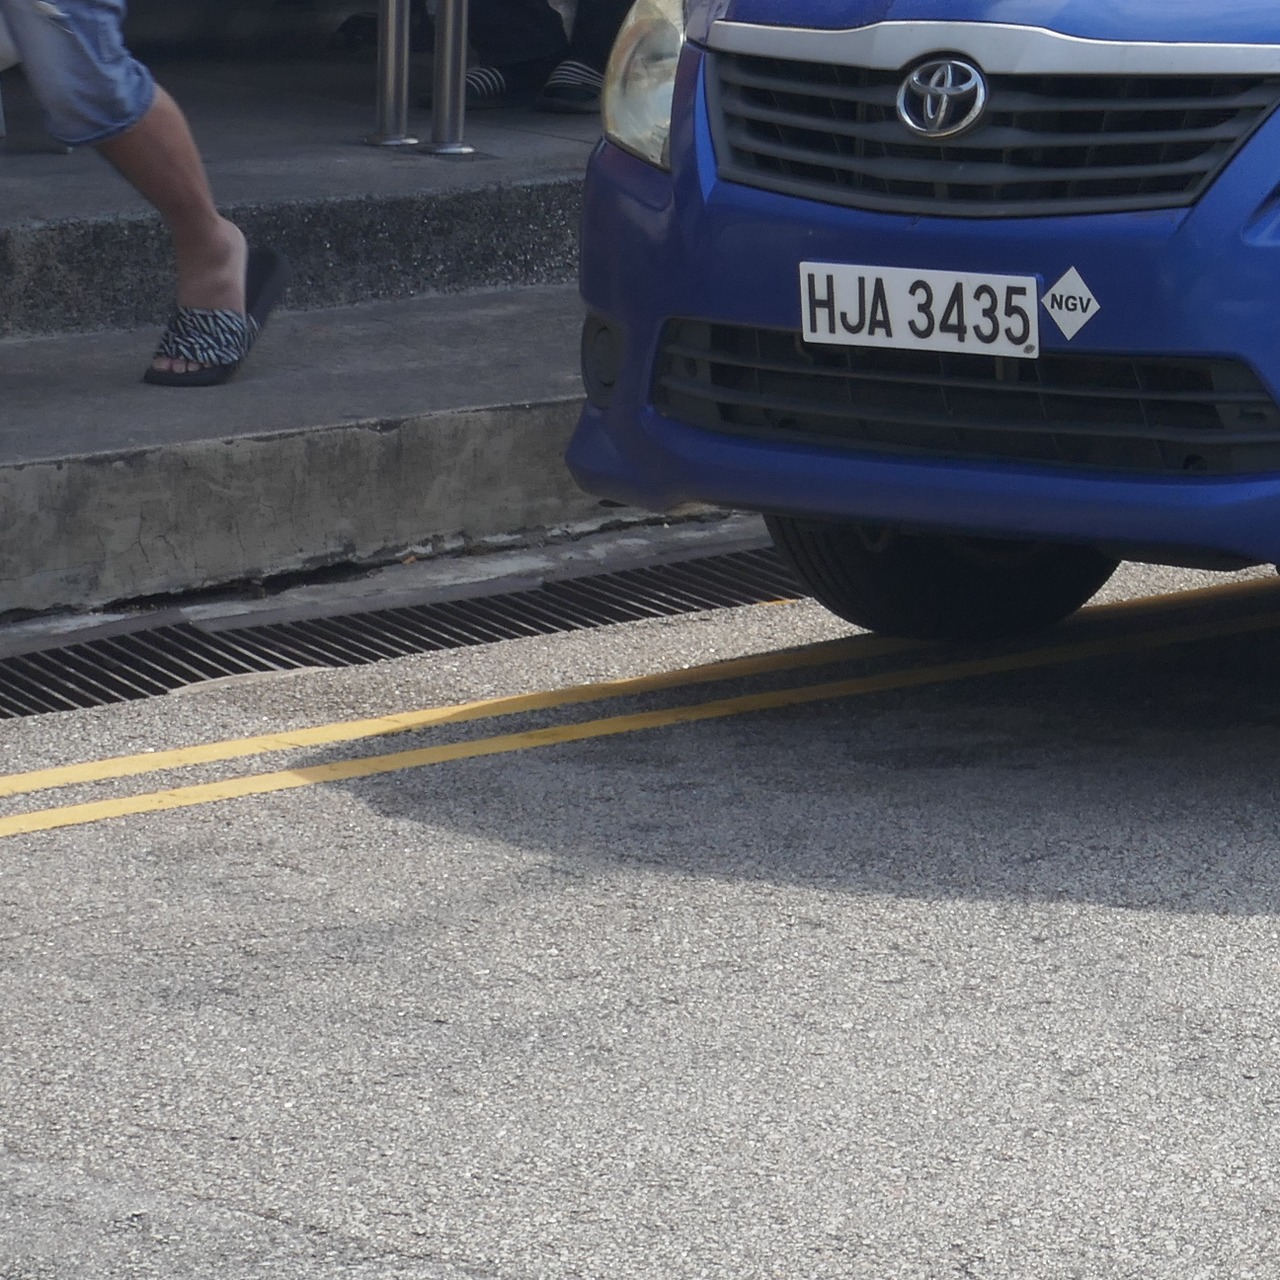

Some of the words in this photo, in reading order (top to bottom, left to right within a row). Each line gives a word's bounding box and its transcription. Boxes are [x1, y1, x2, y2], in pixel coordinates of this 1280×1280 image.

[807, 272, 893, 338] HJA
[907, 279, 1031, 346] 3435
[1050, 293, 1092, 314] NGV
